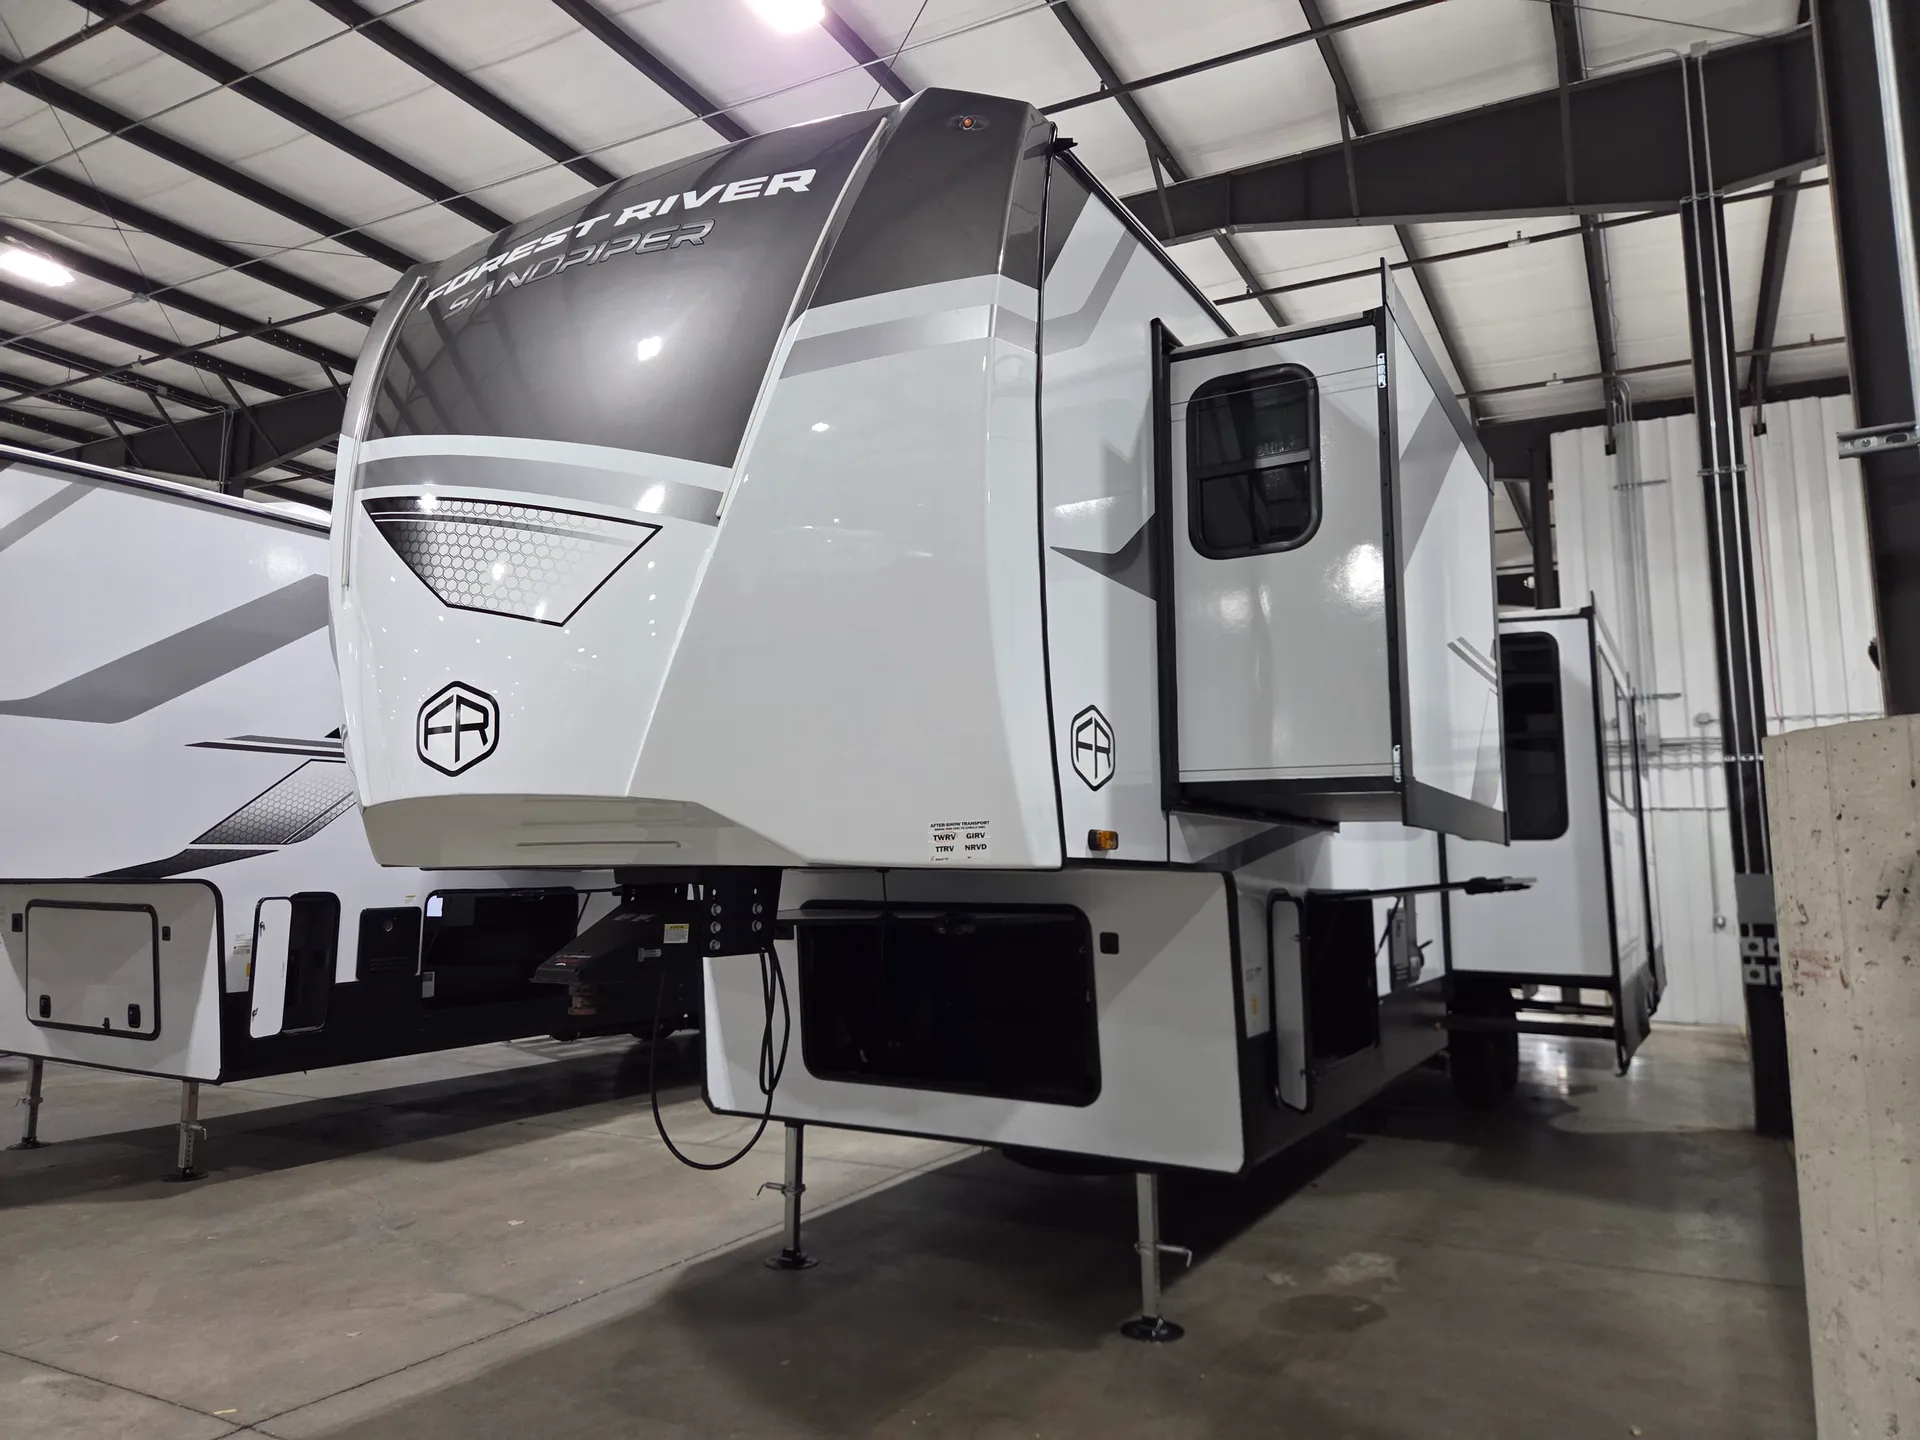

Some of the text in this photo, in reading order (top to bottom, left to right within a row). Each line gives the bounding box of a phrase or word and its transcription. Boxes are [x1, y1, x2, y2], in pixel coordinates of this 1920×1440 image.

[419, 168, 817, 310] FOREST RIVER
[442, 218, 716, 320] SANDPIPER
[933, 833, 956, 841] TWRV
[964, 843, 987, 851] NRVD
